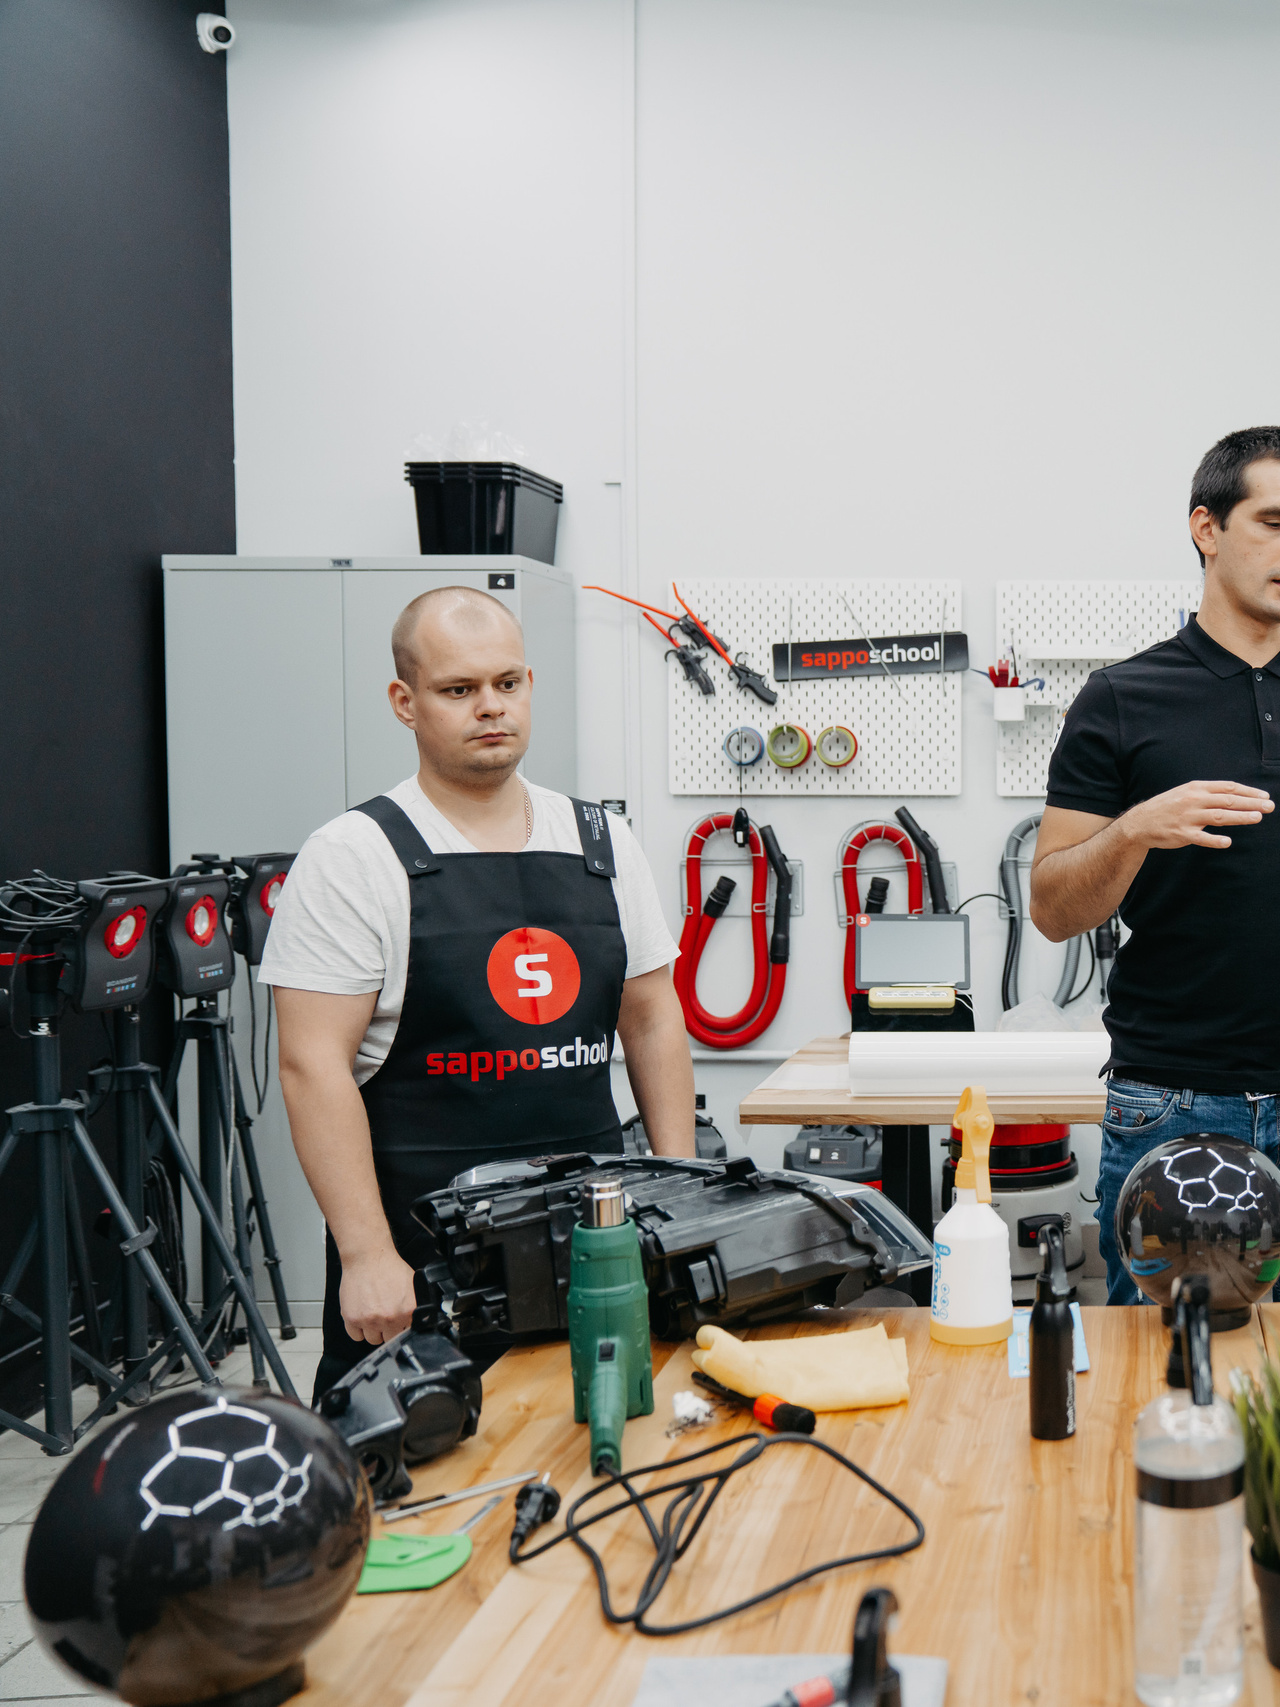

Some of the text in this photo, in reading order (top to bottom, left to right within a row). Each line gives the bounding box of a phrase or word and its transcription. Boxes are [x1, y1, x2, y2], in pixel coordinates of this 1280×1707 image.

[497, 578, 506, 587] 4
[801, 641, 941, 671] sapposchool
[426, 1034, 608, 1082] sapposchool
[830, 1151, 839, 1160] 2
